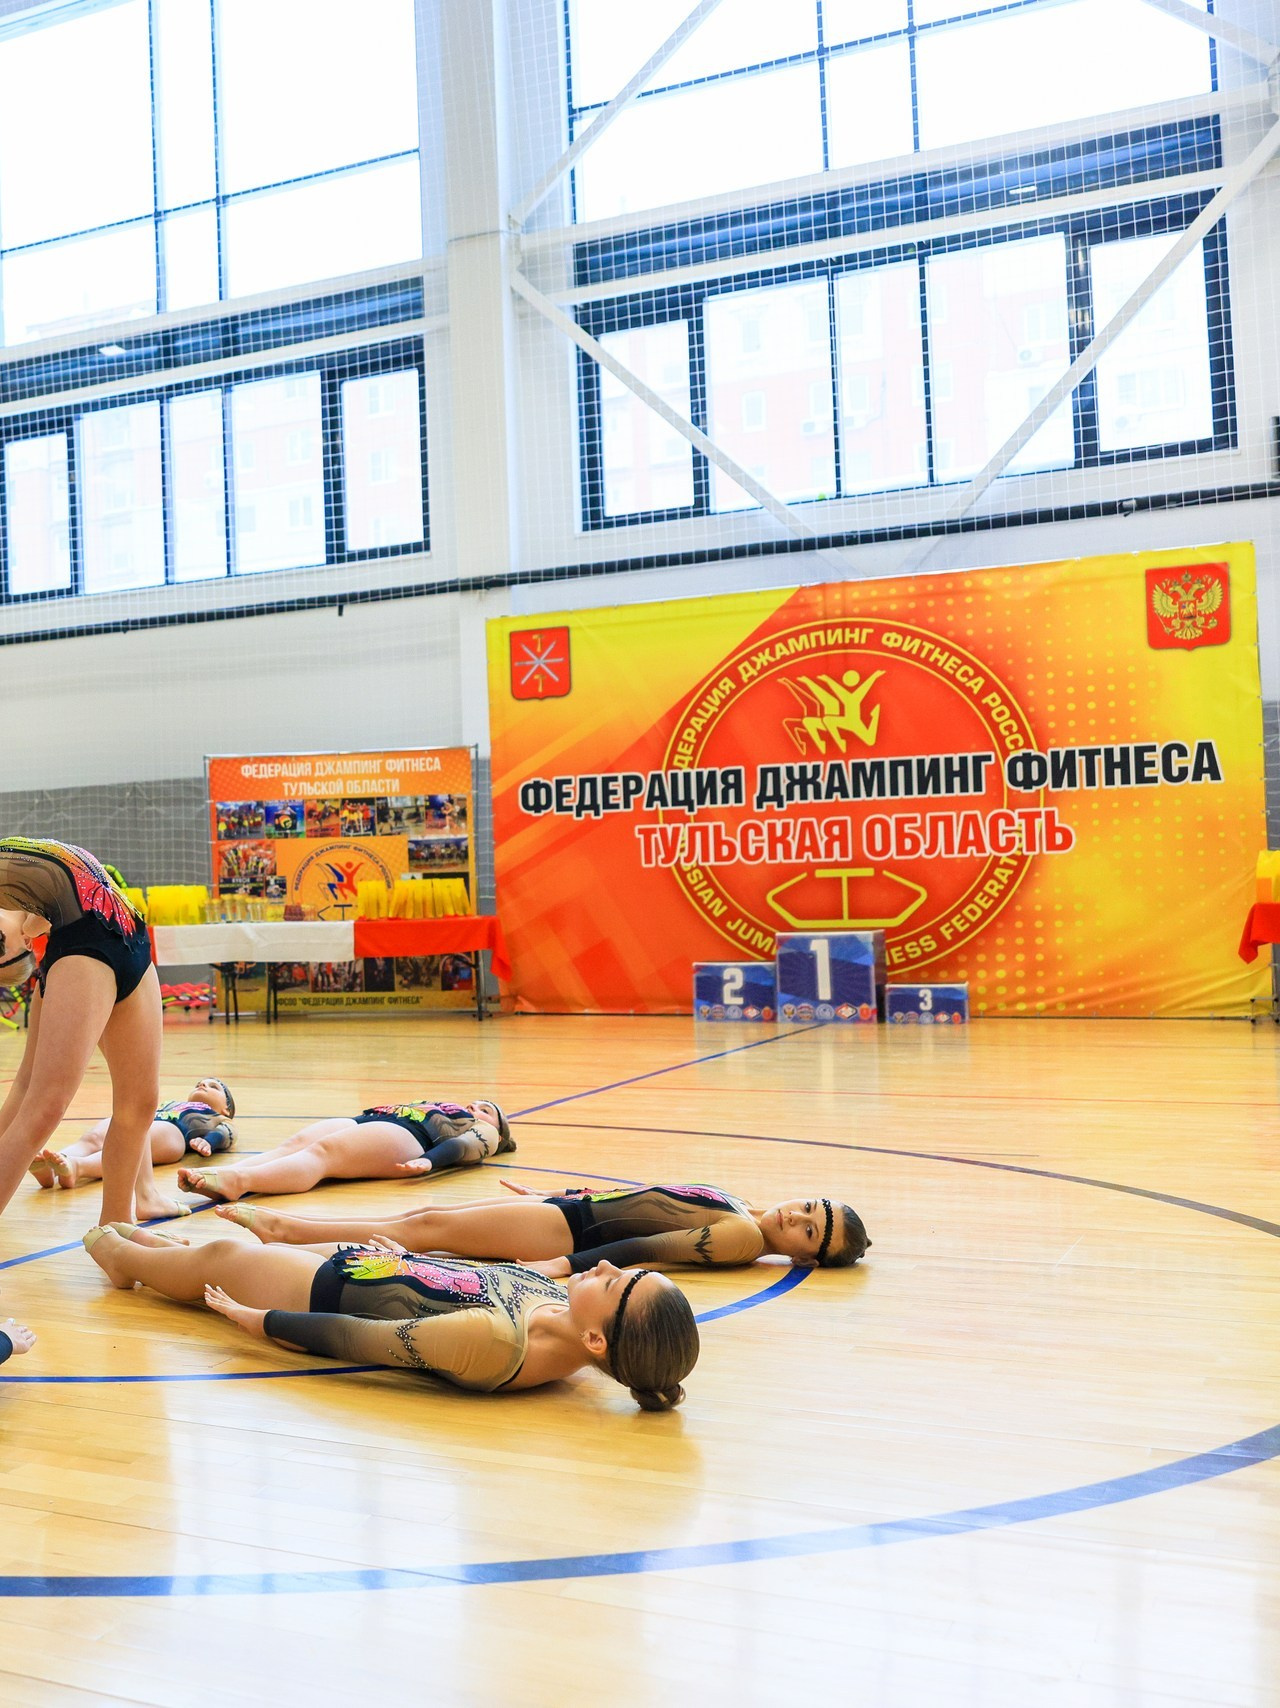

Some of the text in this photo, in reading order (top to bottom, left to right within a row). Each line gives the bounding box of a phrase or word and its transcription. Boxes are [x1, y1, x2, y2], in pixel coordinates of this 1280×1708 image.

[673, 627, 1026, 770] ДЕРАЦИЯ ДЖАМПИНГ ФИТНЕСА РОСС
[241, 757, 442, 779] ФЕДЕРАЦИЯ ДЖАМПИНГ ФИТНЕСА
[282, 777, 400, 796] ТУЛЬСКОЙ ОБЛАСТИ
[520, 740, 1224, 819] ФЕДЕРАЦИЯ ДЖАМПИНГ ФИТНЕСА
[635, 807, 1075, 868] ТУЛЬСКАЯ ОБЛАСТЬ
[722, 967, 744, 1005] 2
[810, 938, 831, 1000] 1
[918, 988, 933, 1011] 3
